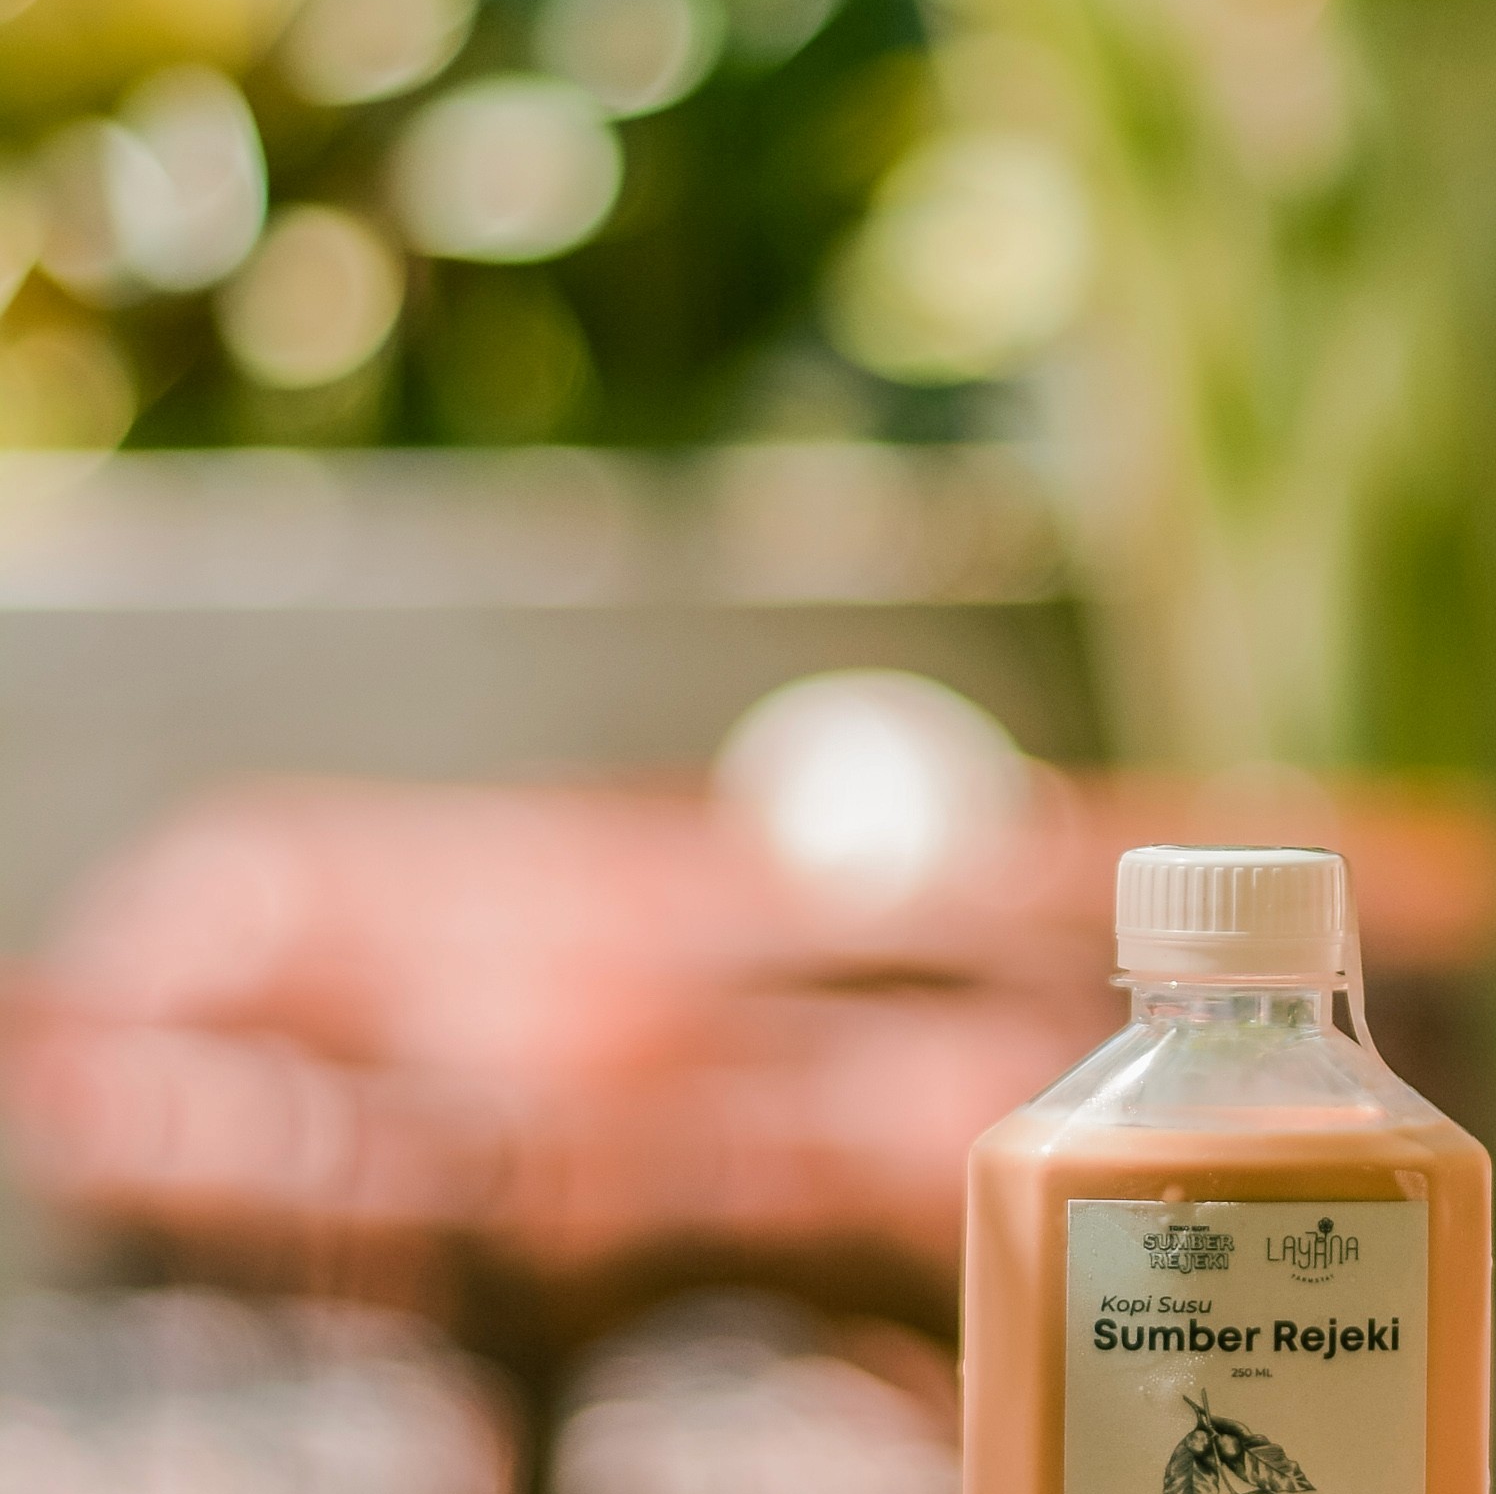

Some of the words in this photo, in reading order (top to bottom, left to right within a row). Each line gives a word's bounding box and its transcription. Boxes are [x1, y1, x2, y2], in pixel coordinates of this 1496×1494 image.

[1143, 1233, 1235, 1252] SUMBER
[1149, 1251, 1230, 1274] REJEKI
[1101, 1295, 1152, 1316] Kopi
[1158, 1296, 1212, 1314] Susu
[1093, 1318, 1261, 1352] Sumber
[1273, 1317, 1400, 1359] Rejeki
[1231, 1368, 1252, 1378] 250
[1256, 1368, 1273, 1378] ML
